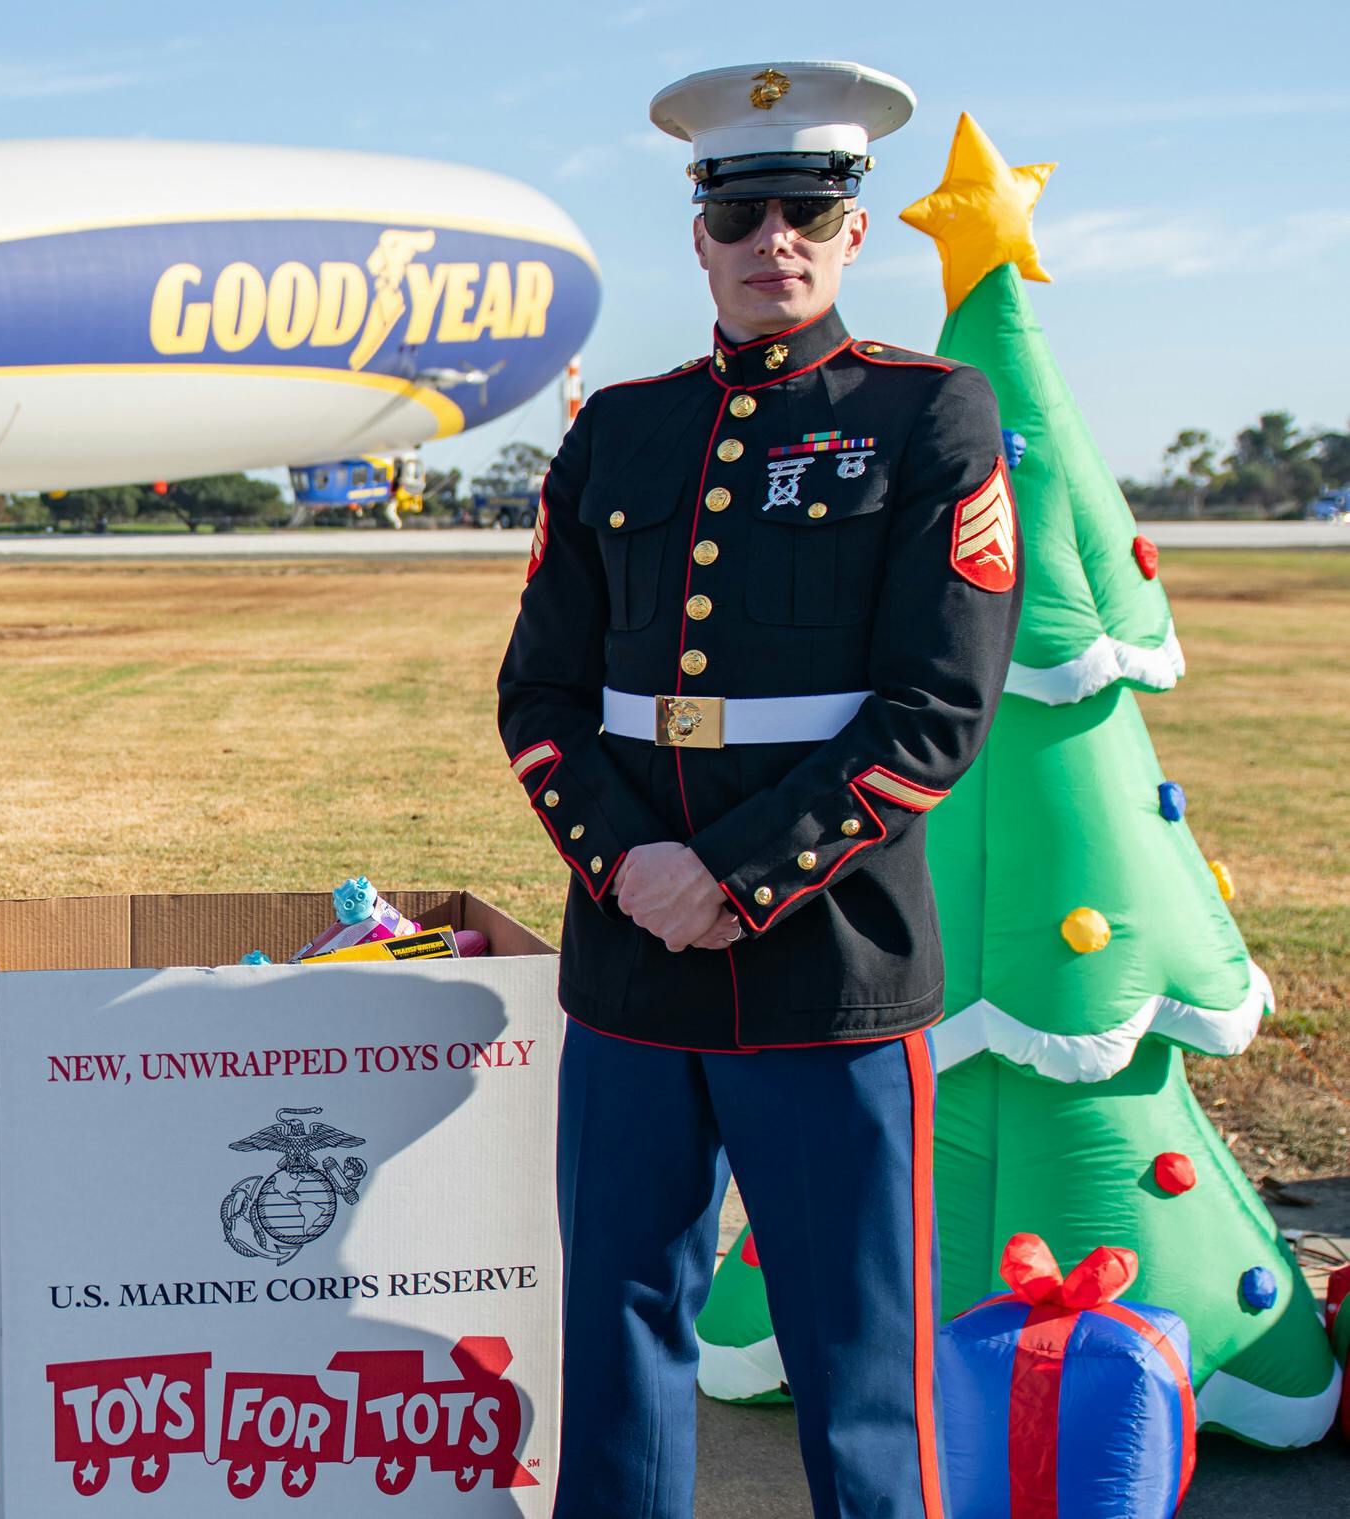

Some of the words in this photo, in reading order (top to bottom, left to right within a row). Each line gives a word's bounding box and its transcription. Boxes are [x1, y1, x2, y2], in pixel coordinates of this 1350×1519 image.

[48, 1054, 132, 1085] NEW,
[140, 1047, 347, 1080] UNWRAPPED
[355, 1044, 438, 1073] TOYS
[445, 1040, 536, 1070] ONLY
[48, 1284, 109, 1308] U.S.
[118, 1280, 258, 1307] MARINE
[266, 1275, 379, 1303] CORPS
[387, 1265, 538, 1297] RESERVE
[63, 1373, 194, 1445] TOYS
[227, 1388, 331, 1452] FOR
[365, 1391, 500, 1456] TOTS
[527, 1458, 540, 1468] SM
